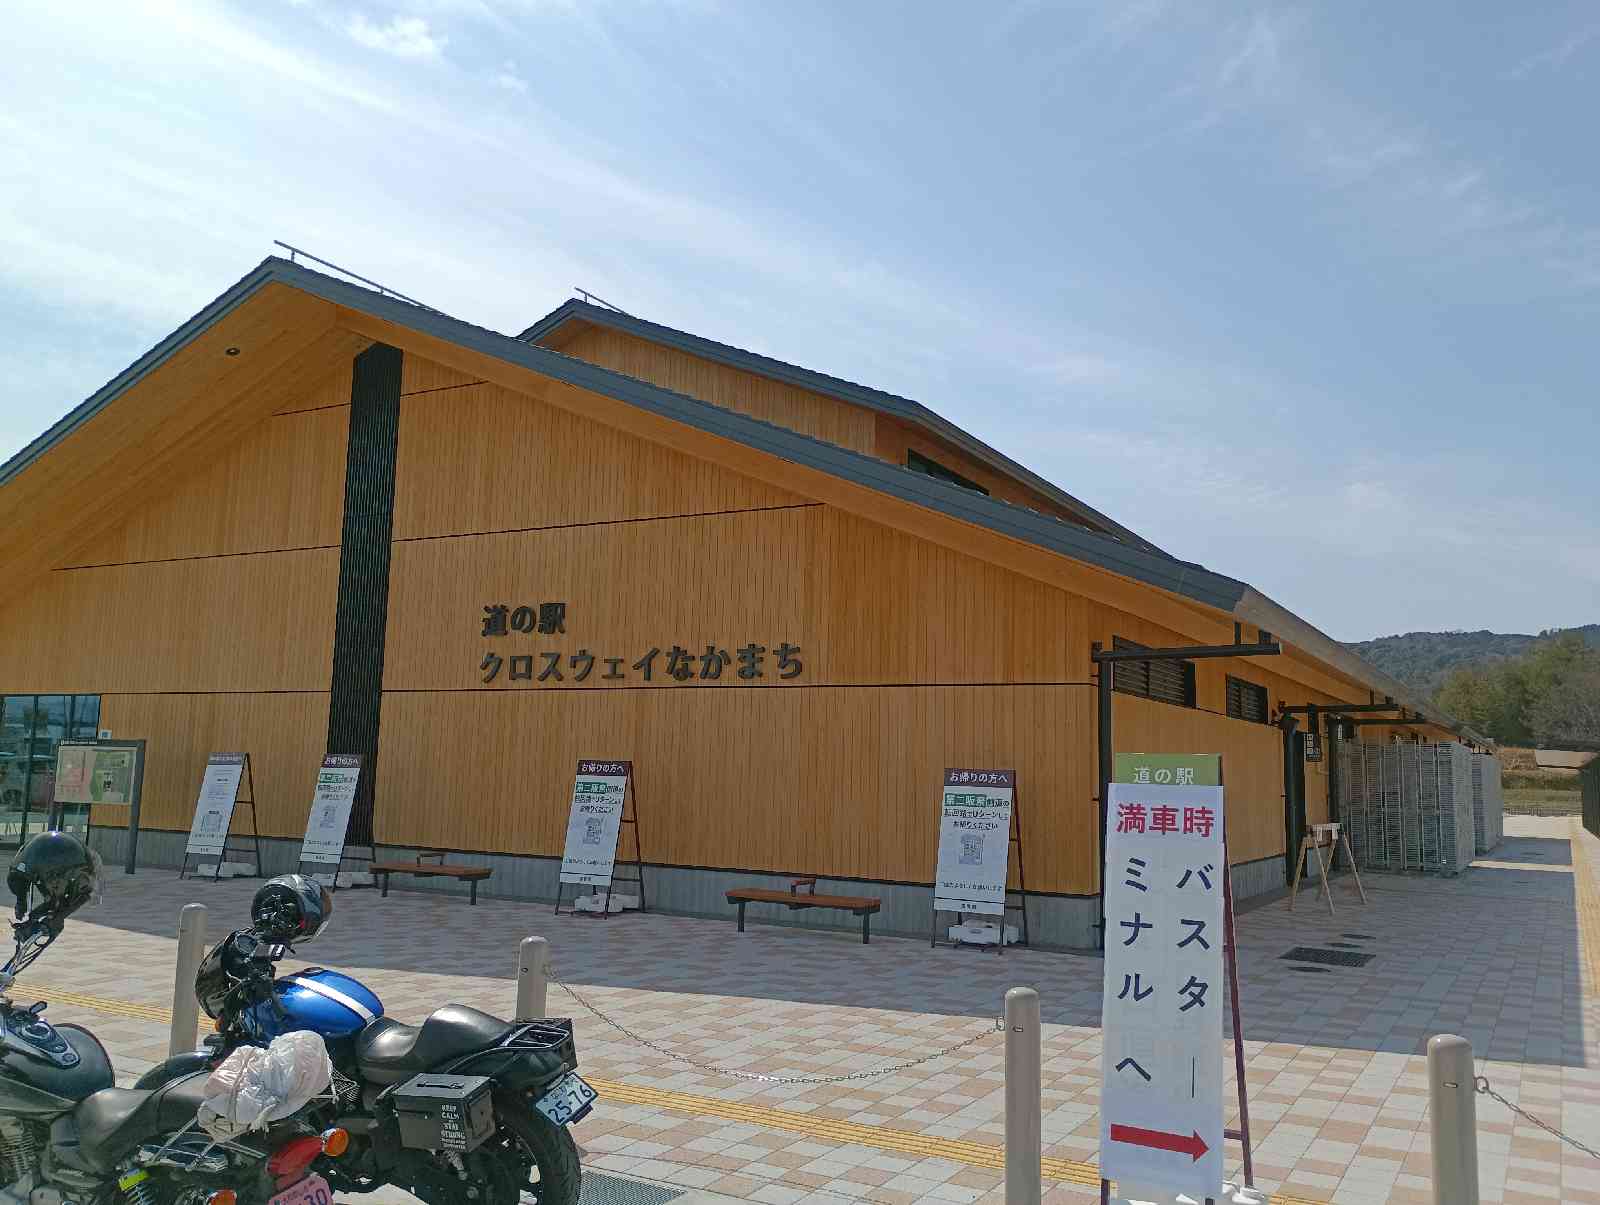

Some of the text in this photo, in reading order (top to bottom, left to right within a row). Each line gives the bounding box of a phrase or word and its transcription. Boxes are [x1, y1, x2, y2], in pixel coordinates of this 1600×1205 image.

[482, 602, 566, 636] 道の駅
[480, 643, 803, 683] クロスウェイなかまち
[582, 763, 625, 774] お帰りの方へ
[950, 771, 1008, 784] お帰りの方へ
[1133, 766, 1194, 785] 道の駅
[1116, 803, 1215, 837] 満車時
[1115, 857, 1154, 1083] ミナルへ
[1176, 863, 1214, 1099] バスター
[548, 1084, 592, 1123] 25-76
